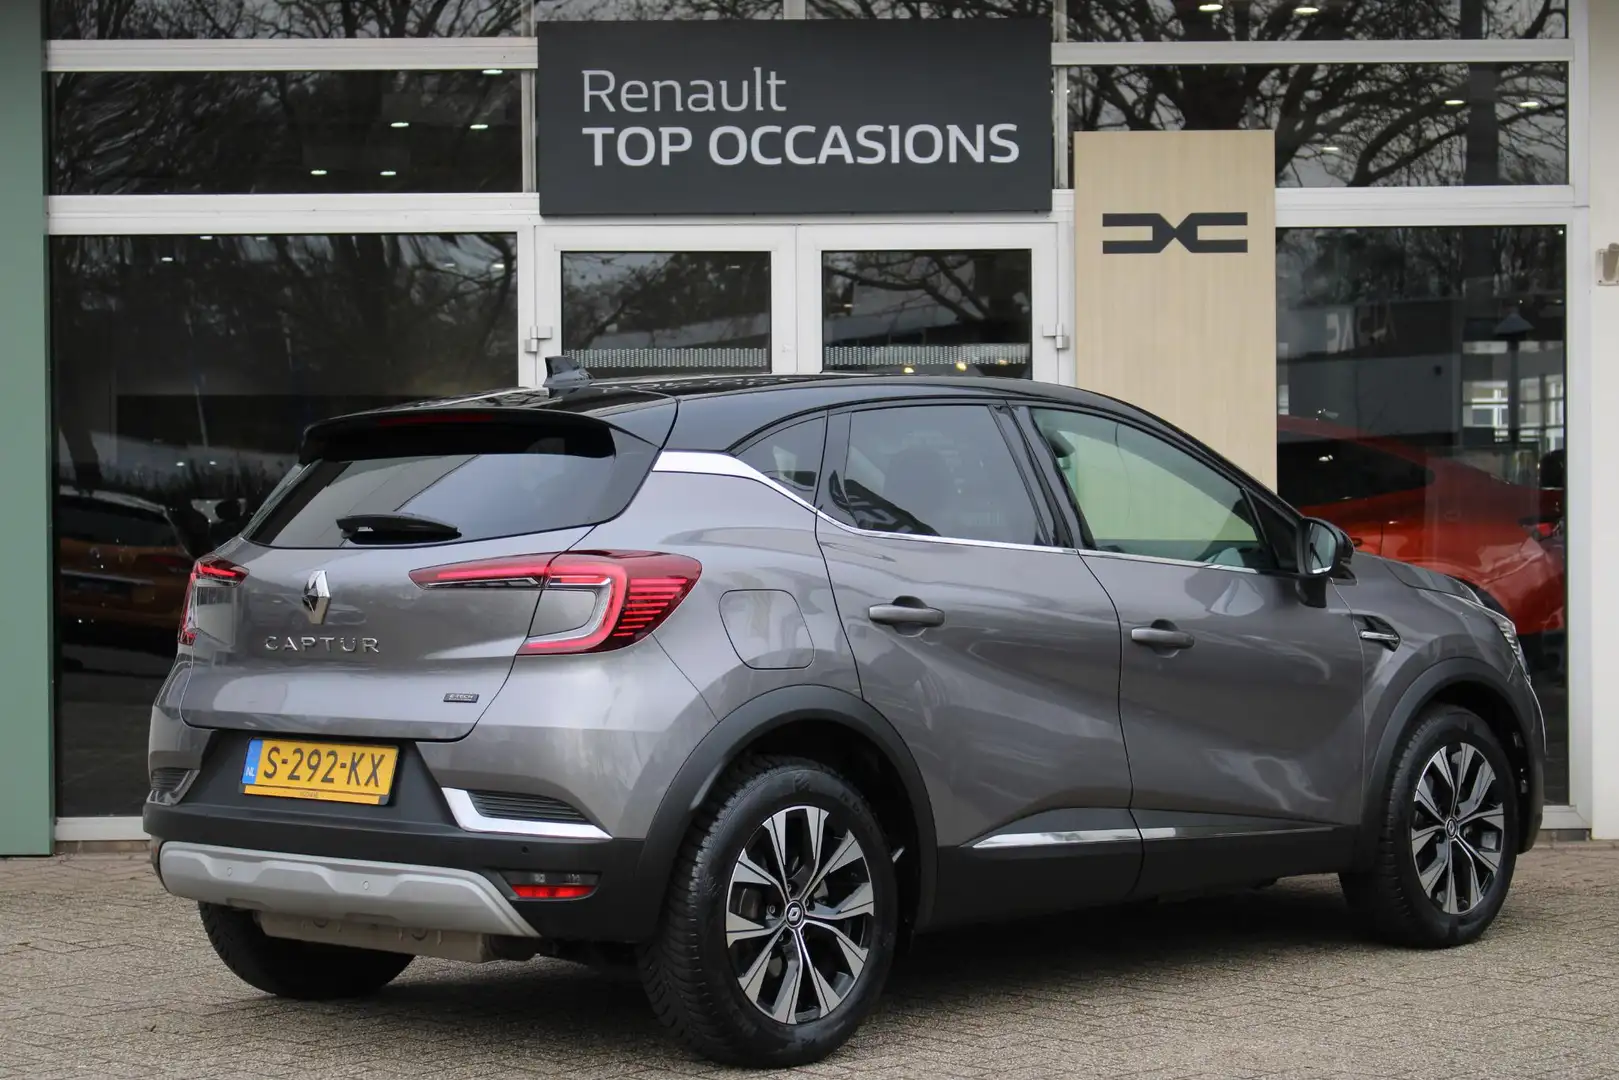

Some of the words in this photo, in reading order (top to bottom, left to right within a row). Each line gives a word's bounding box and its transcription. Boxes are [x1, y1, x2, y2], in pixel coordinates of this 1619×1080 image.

[582, 67, 787, 113] Renault
[582, 127, 692, 167] TOP
[709, 123, 1020, 166] OCCASIONS
[265, 635, 379, 653] CAPTUR
[245, 767, 255, 777] NL
[263, 746, 386, 788] S-292-KX
